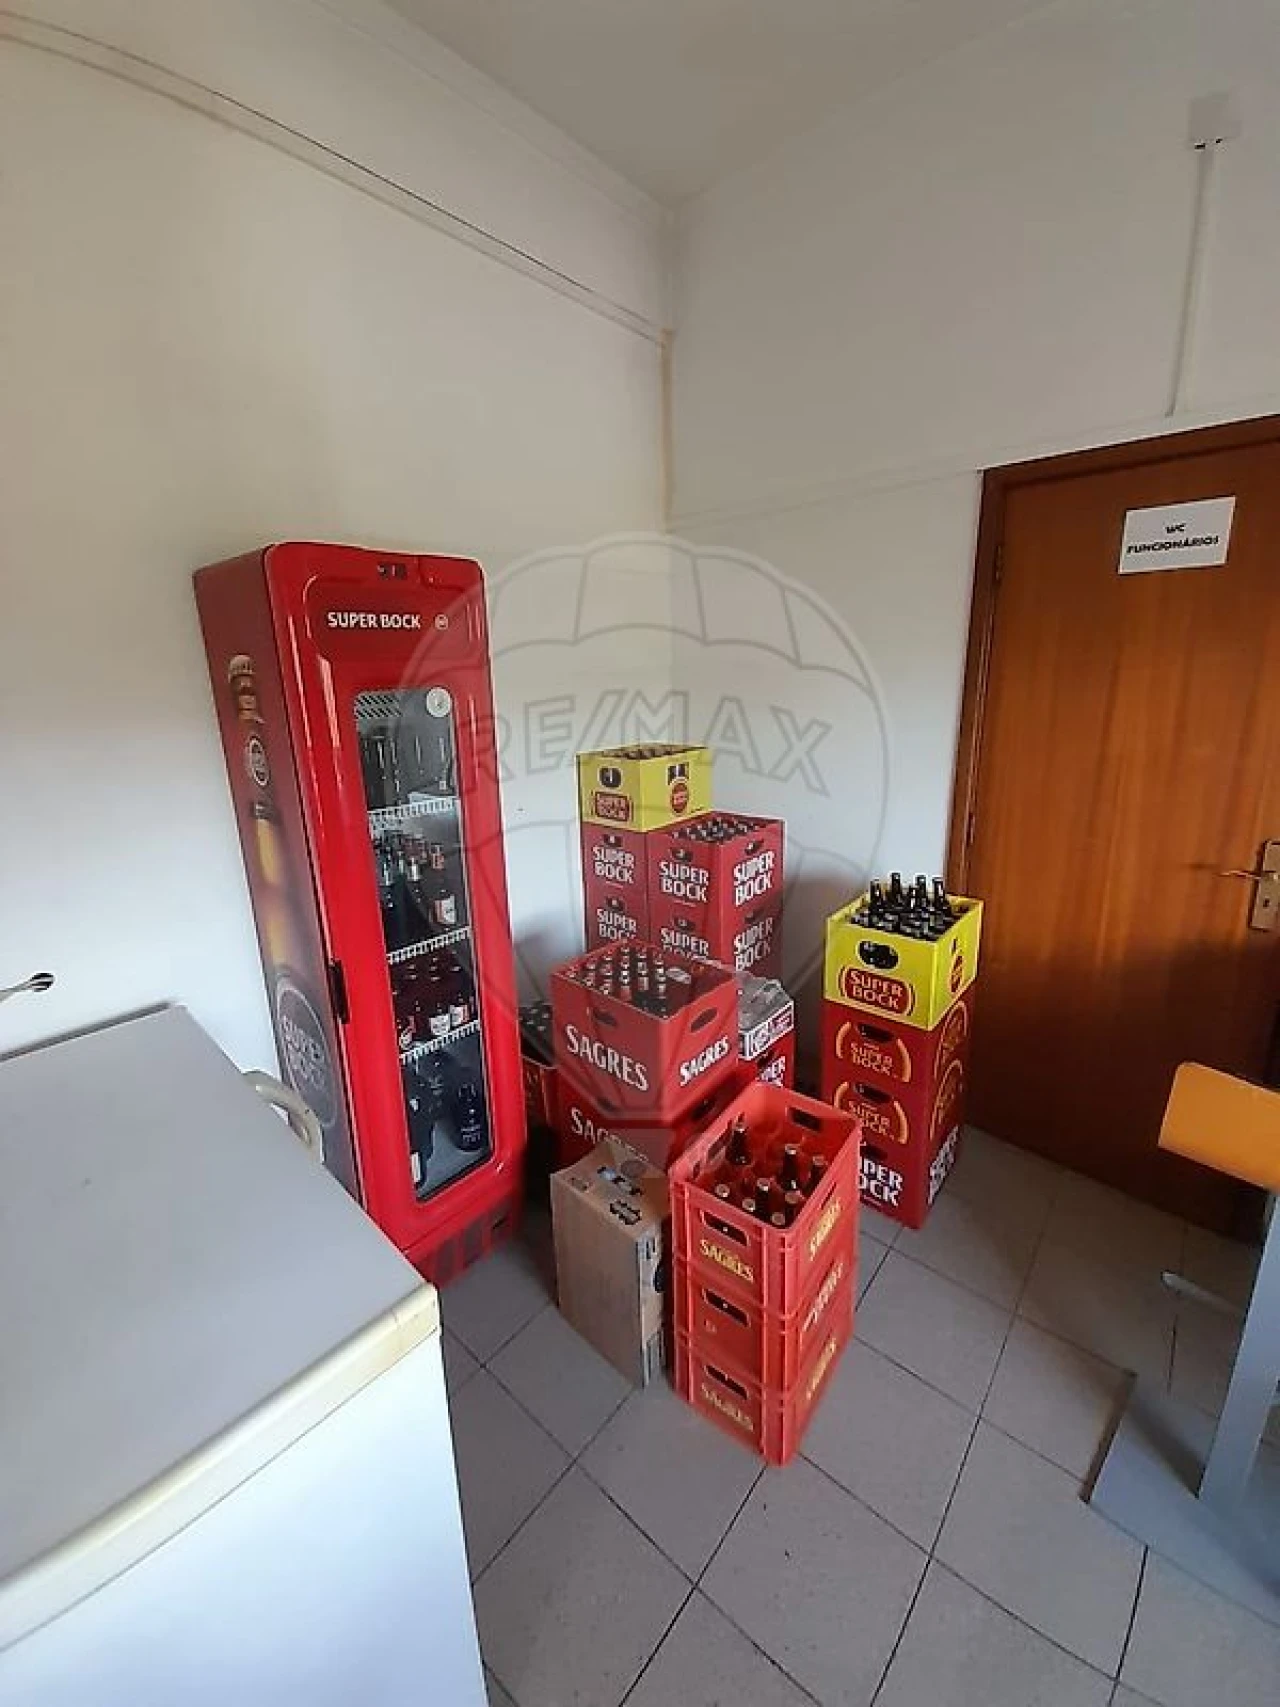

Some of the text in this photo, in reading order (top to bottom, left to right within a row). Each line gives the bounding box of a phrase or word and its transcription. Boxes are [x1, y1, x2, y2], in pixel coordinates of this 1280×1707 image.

[327, 611, 421, 629] SUPER BOCK
[592, 845, 635, 871] SUPER
[733, 851, 774, 887] SUPER
[594, 862, 634, 884] BOCK
[659, 861, 709, 888] SUPER
[662, 878, 707, 903] BOCK
[735, 872, 772, 906] BOCK
[597, 907, 637, 933] SUPER
[661, 927, 709, 956] SUPER
[733, 917, 773, 955] SUPER
[735, 939, 771, 973] BOCK
[850, 969, 904, 998] SUPER
[852, 985, 899, 1009] BOCK
[565, 1023, 650, 1092] SAGRES
[680, 1036, 730, 1087] SAGRES
[850, 1042, 893, 1068] SUPER
[852, 1053, 892, 1076] BOCK
[848, 1100, 891, 1128] SUPER
[860, 1116, 888, 1136] OCK
[859, 1173, 899, 1207] OCK
[699, 1239, 754, 1284] SAGRES
